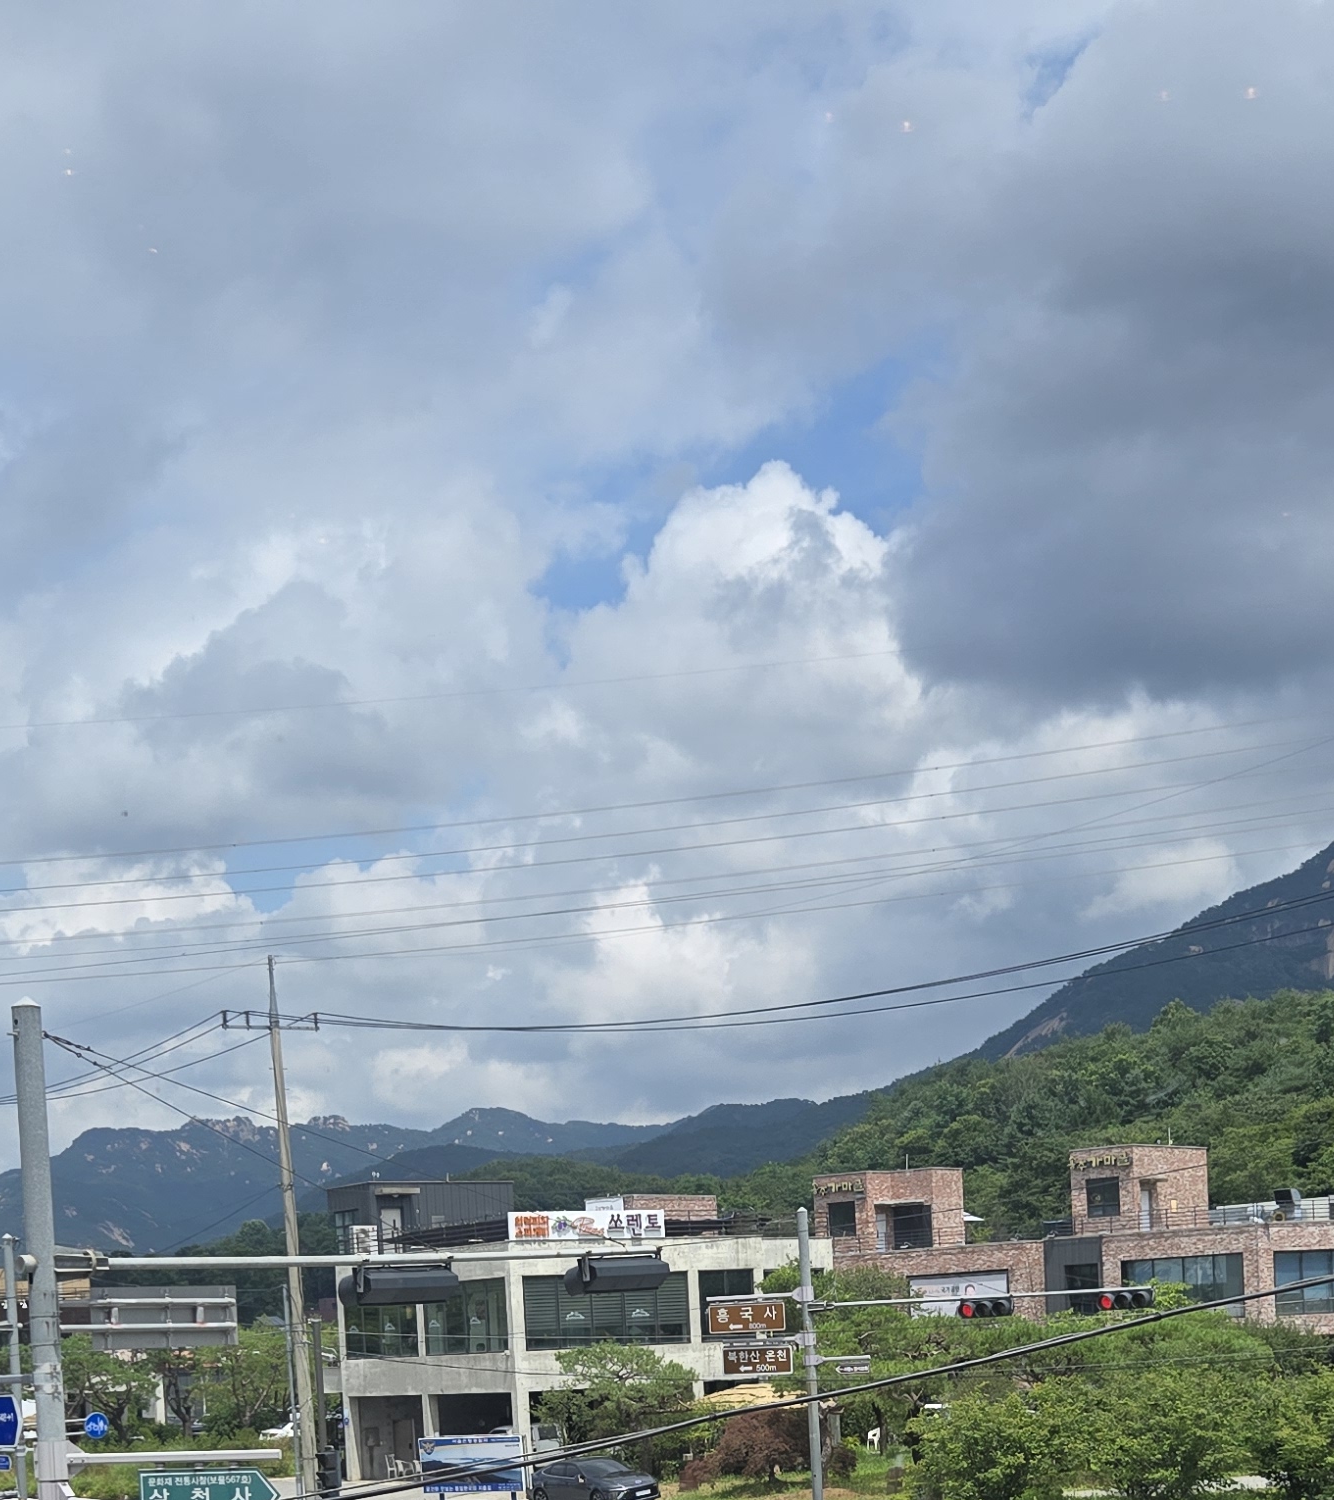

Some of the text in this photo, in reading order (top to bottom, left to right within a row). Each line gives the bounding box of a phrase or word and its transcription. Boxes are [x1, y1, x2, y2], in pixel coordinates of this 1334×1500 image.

[609, 1213, 662, 1237] 쏘렌토
[716, 1305, 777, 1323] 흥국사
[728, 1349, 787, 1363] 북한산 온천
[756, 1363, 777, 1372] 500m
[148, 1477, 173, 1486] 문화재
